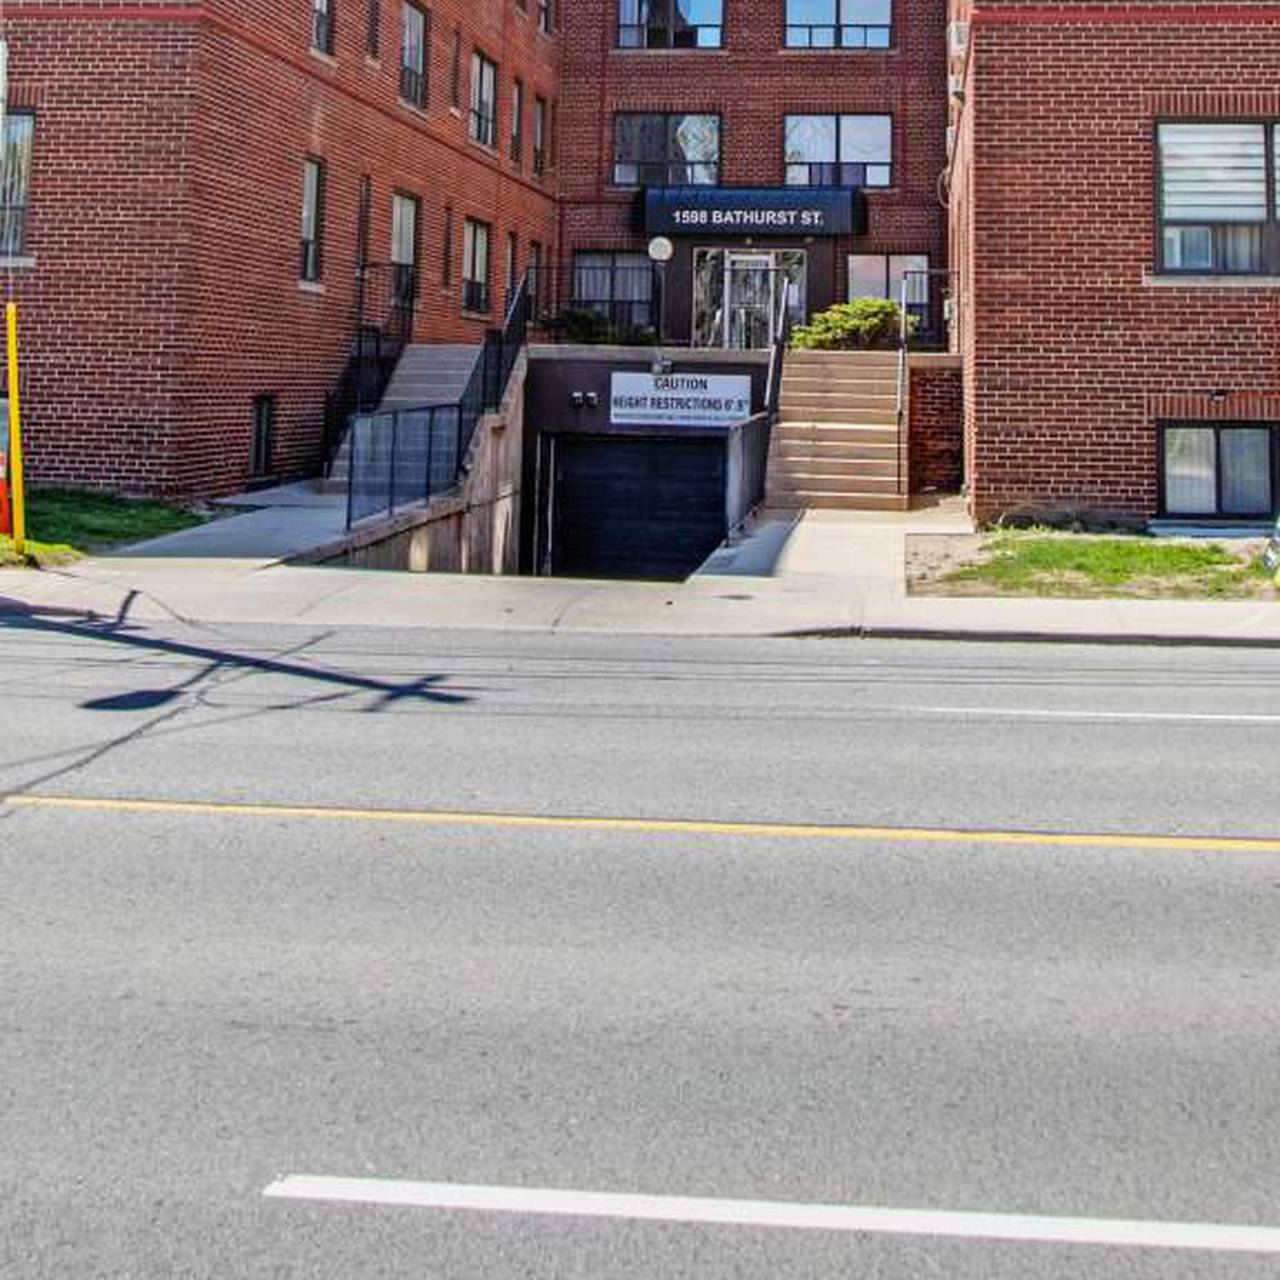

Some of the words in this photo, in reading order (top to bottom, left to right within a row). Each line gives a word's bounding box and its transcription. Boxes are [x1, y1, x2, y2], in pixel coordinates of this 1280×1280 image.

[673, 210, 708, 224] 1598
[711, 210, 796, 225] BATHURST
[800, 212, 825, 226] ST.
[654, 378, 708, 391] CAUTION
[650, 397, 722, 411] RESTRICTIONS
